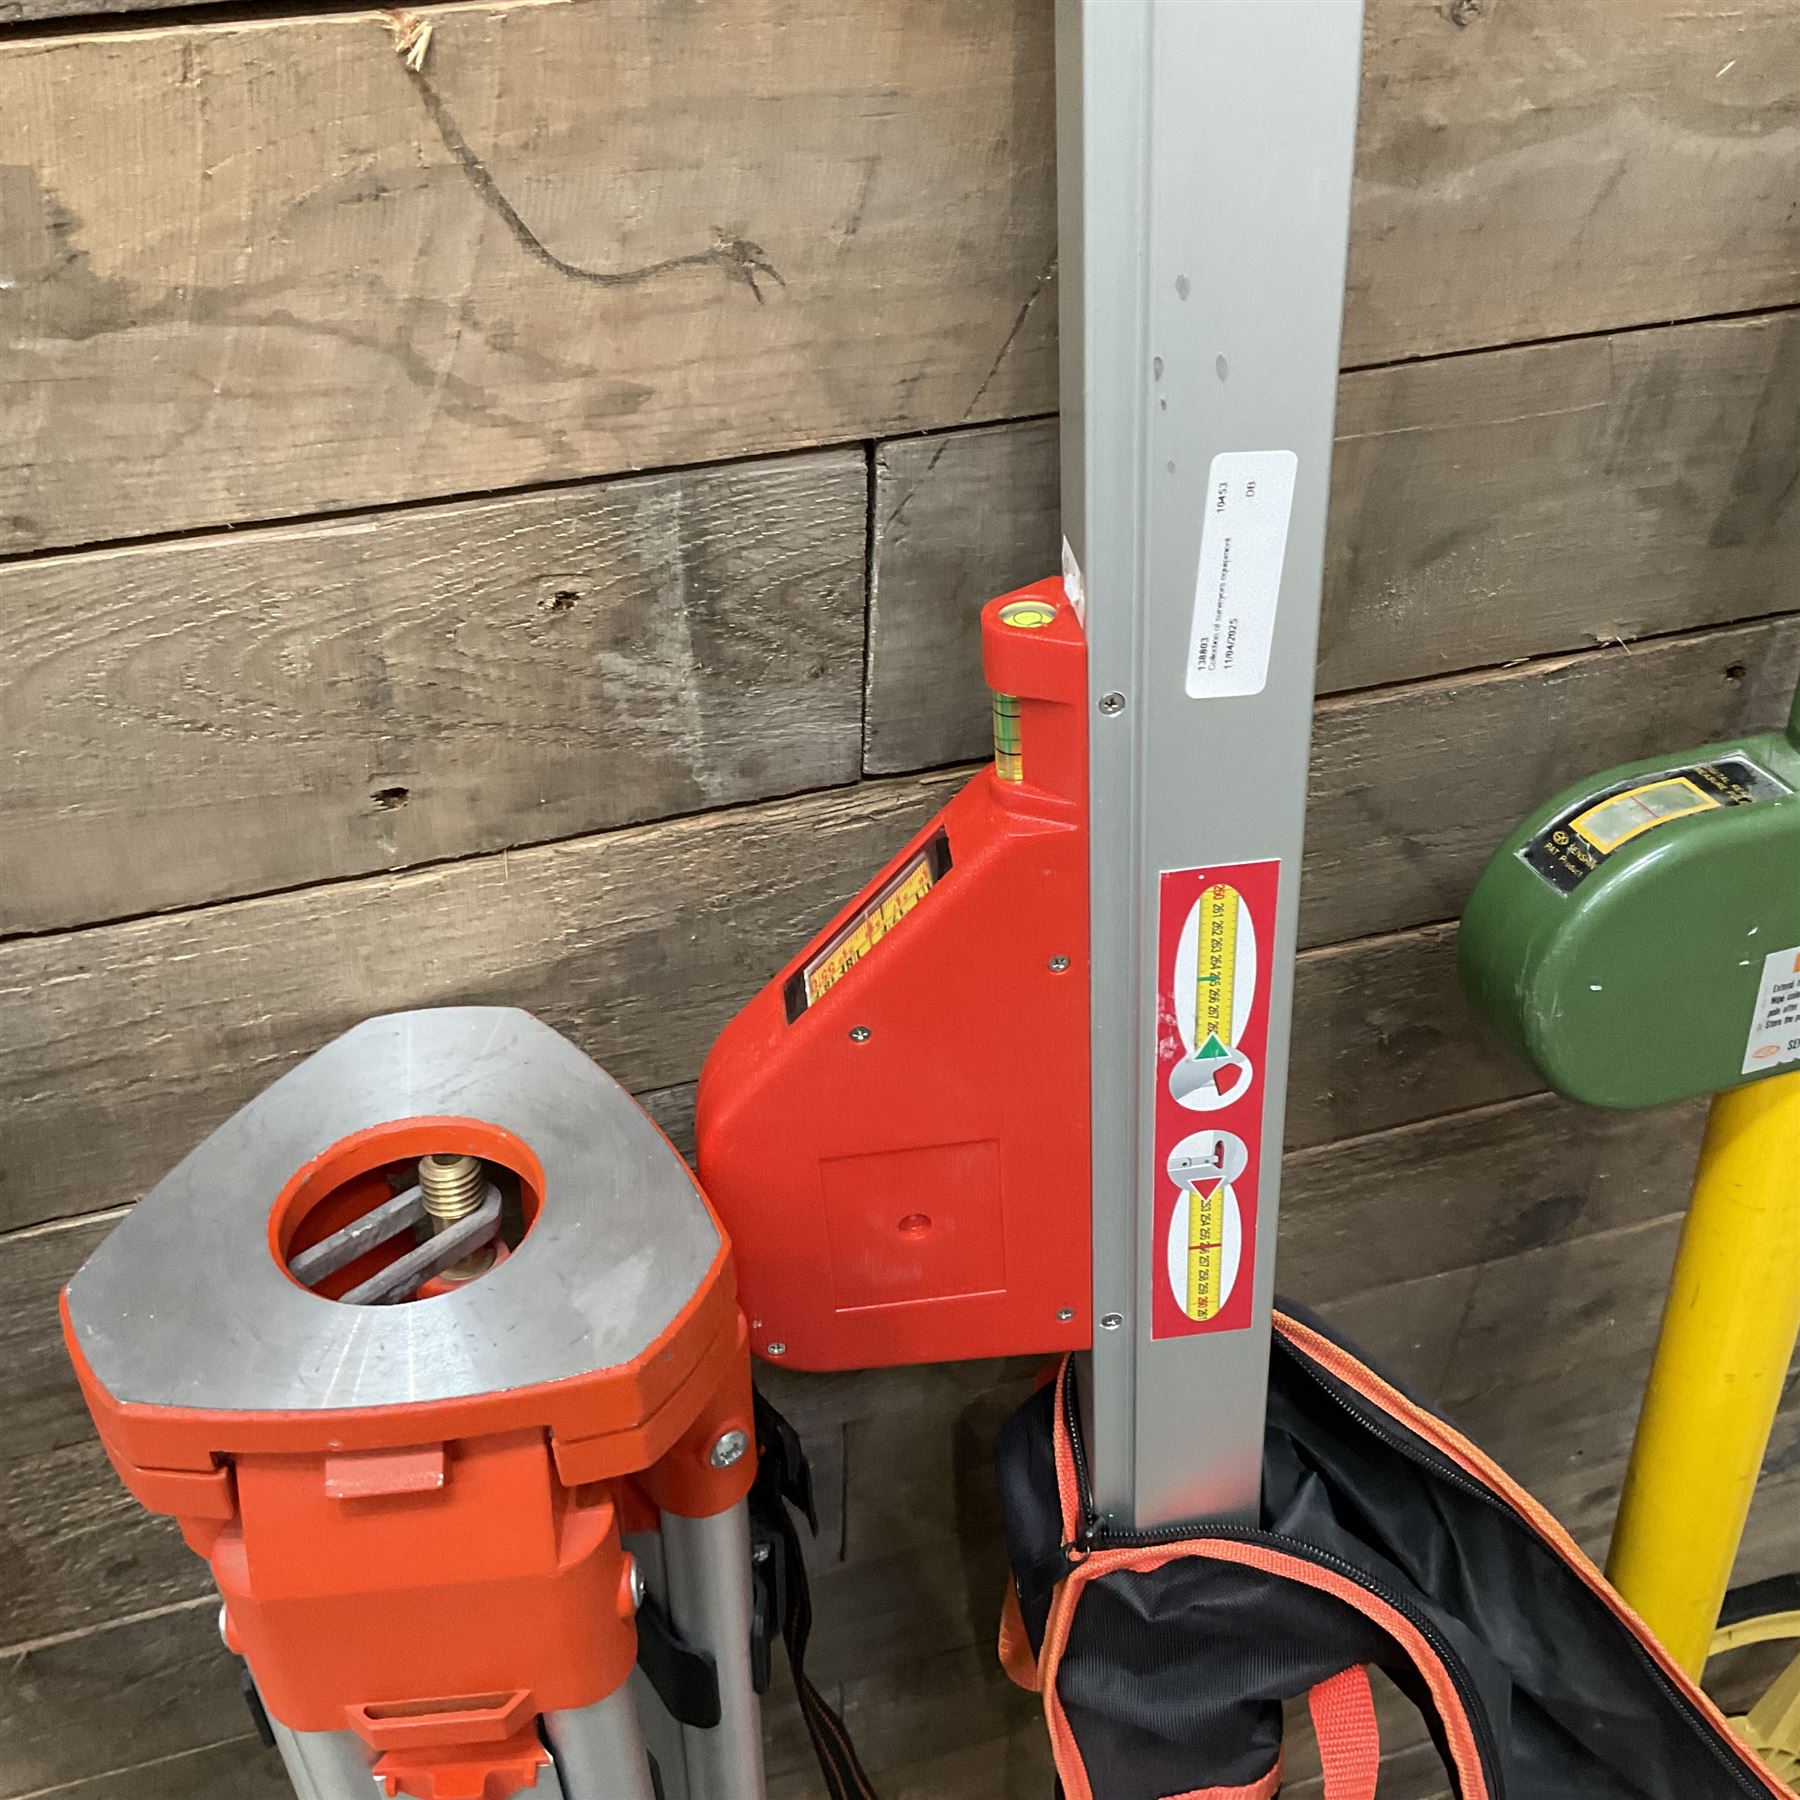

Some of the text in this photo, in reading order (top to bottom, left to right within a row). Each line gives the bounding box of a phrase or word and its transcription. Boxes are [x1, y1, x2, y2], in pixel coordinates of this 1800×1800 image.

[1246, 481, 1256, 497] DB
[1216, 482, 1228, 514] 10453
[1220, 538, 1231, 580] equipment
[1215, 583, 1226, 621] surveyors
[1208, 633, 1219, 671] Collection
[1224, 619, 1237, 670] 11/04/2025
[1198, 637, 1209, 671] 138803
[1544, 842, 1560, 855] PAT
[1213, 885, 1225, 900] 260
[1213, 903, 1224, 917] 261
[1212, 921, 1224, 936] 262
[1212, 938, 1223, 952] 263
[1211, 955, 1222, 969] 264
[1209, 988, 1220, 1003] 266
[1208, 1005, 1220, 1019] 267
[1201, 1213, 1211, 1226] 254
[1200, 1256, 1209, 1267] 257
